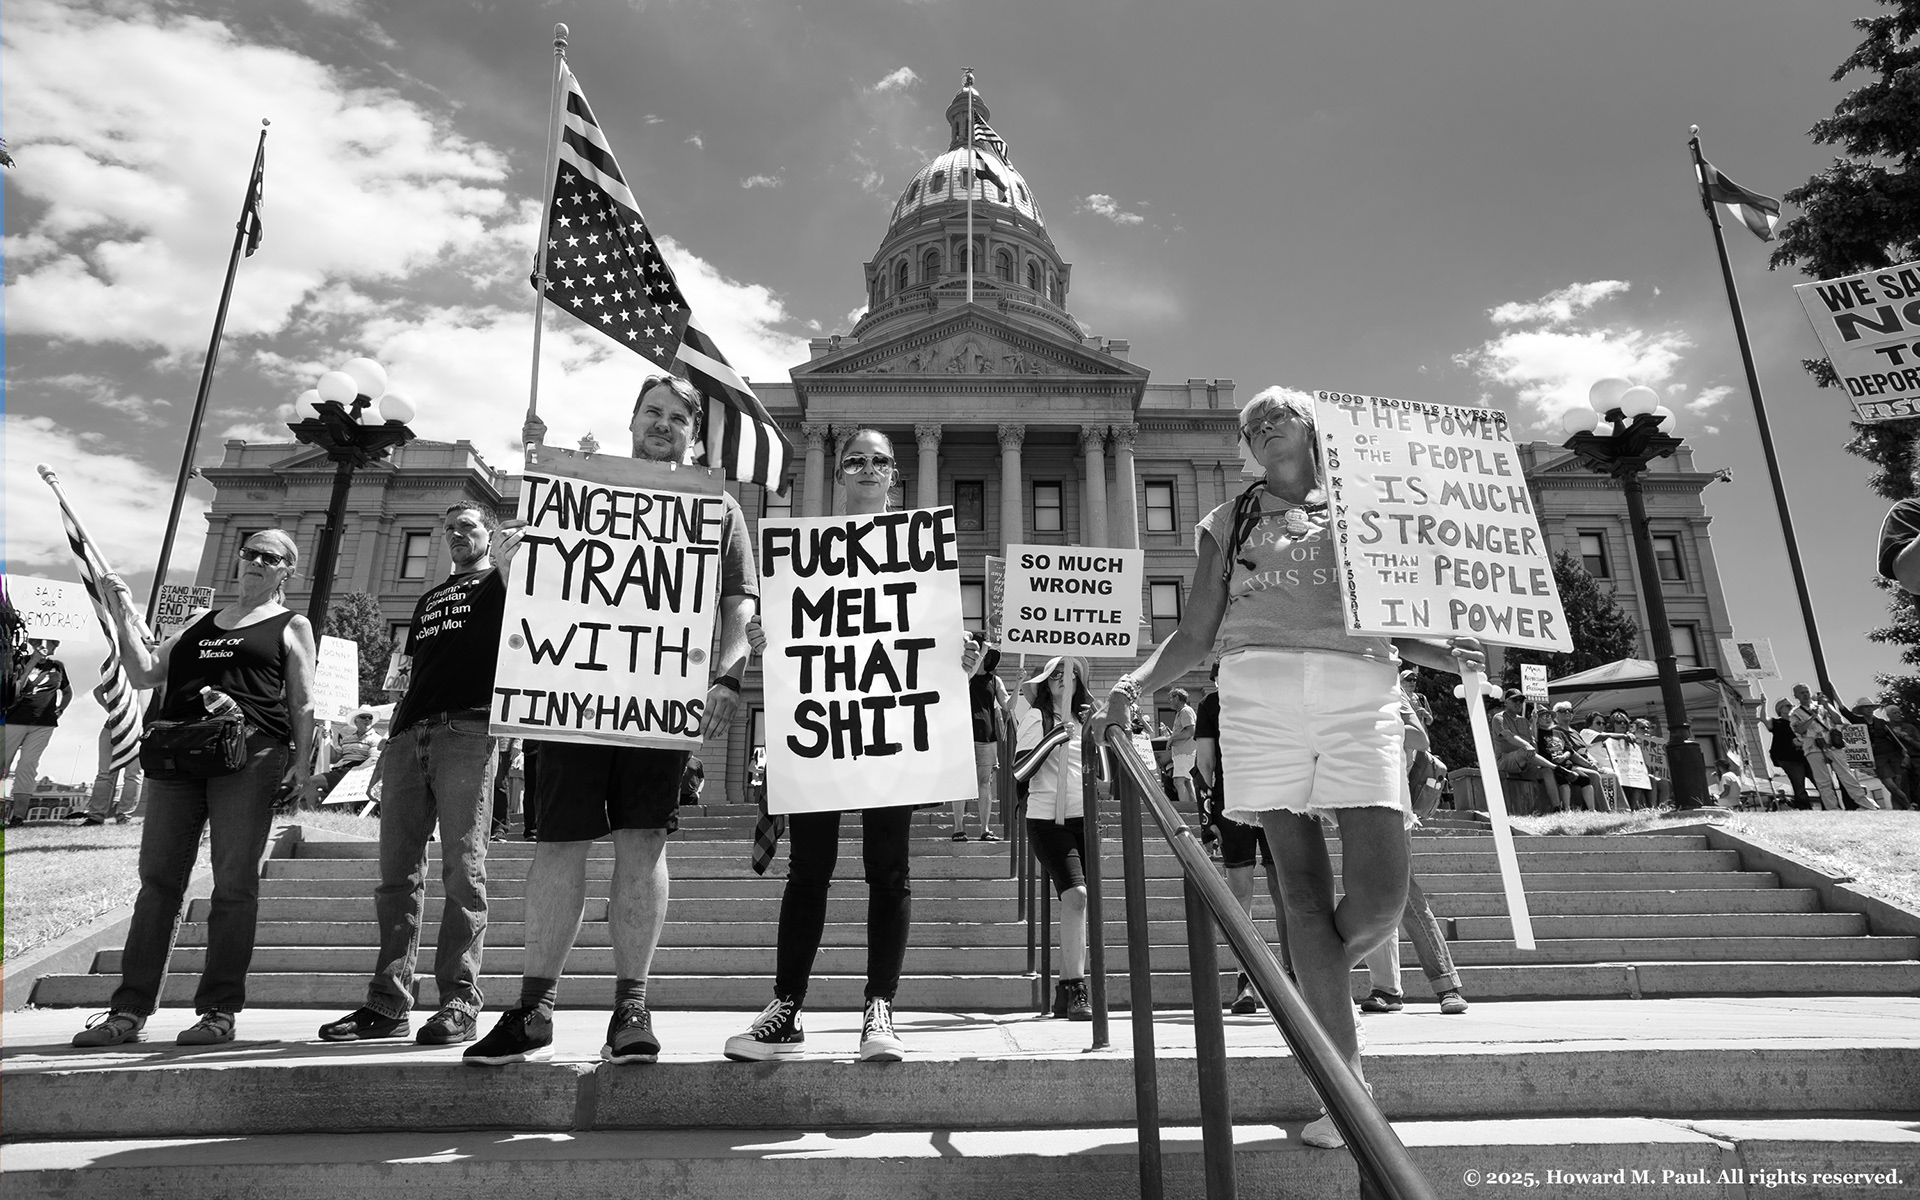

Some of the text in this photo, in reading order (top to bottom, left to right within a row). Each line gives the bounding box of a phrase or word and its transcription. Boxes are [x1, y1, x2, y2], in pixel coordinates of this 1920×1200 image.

[1815, 267, 1920, 312] WE SA
[1319, 391, 1364, 404] GOOD
[1370, 397, 1440, 414] TROUBLE
[1443, 406, 1488, 420] LIVES
[1338, 404, 1512, 443] THE POWER
[1355, 434, 1378, 445] OF
[1327, 447, 1340, 469] NO
[1354, 448, 1391, 462] THE
[1408, 442, 1511, 477] PEOPLE
[1374, 475, 1531, 515] IS MUCH
[523, 475, 723, 545] TANGERINE
[1357, 510, 1538, 556] STRONGER
[1020, 553, 1123, 573] SO MUCH
[1291, 546, 1320, 562] OF
[1363, 552, 1419, 568] THAN
[520, 534, 719, 613] TYRANT
[1242, 569, 1300, 591] THIS
[1377, 569, 1419, 584] THE
[1435, 554, 1550, 597] PEOPLE
[35, 587, 63, 599] SAVE
[162, 585, 212, 596] STAND WITH
[1029, 577, 1113, 595] WRONG
[158, 603, 183, 616] END
[160, 594, 211, 606] PALESTINE!
[451, 605, 471, 614] am
[791, 582, 917, 639] MELT
[1019, 606, 1047, 621] SO
[1054, 608, 1122, 624] LITTLE
[1380, 598, 1557, 641] IN POWER
[198, 638, 226, 647] Gulf
[521, 618, 690, 677] WITH
[1007, 628, 1131, 646] CARDBOARD
[198, 649, 234, 659] Mexico
[784, 638, 936, 694] THAT
[786, 691, 940, 761] SHIT
